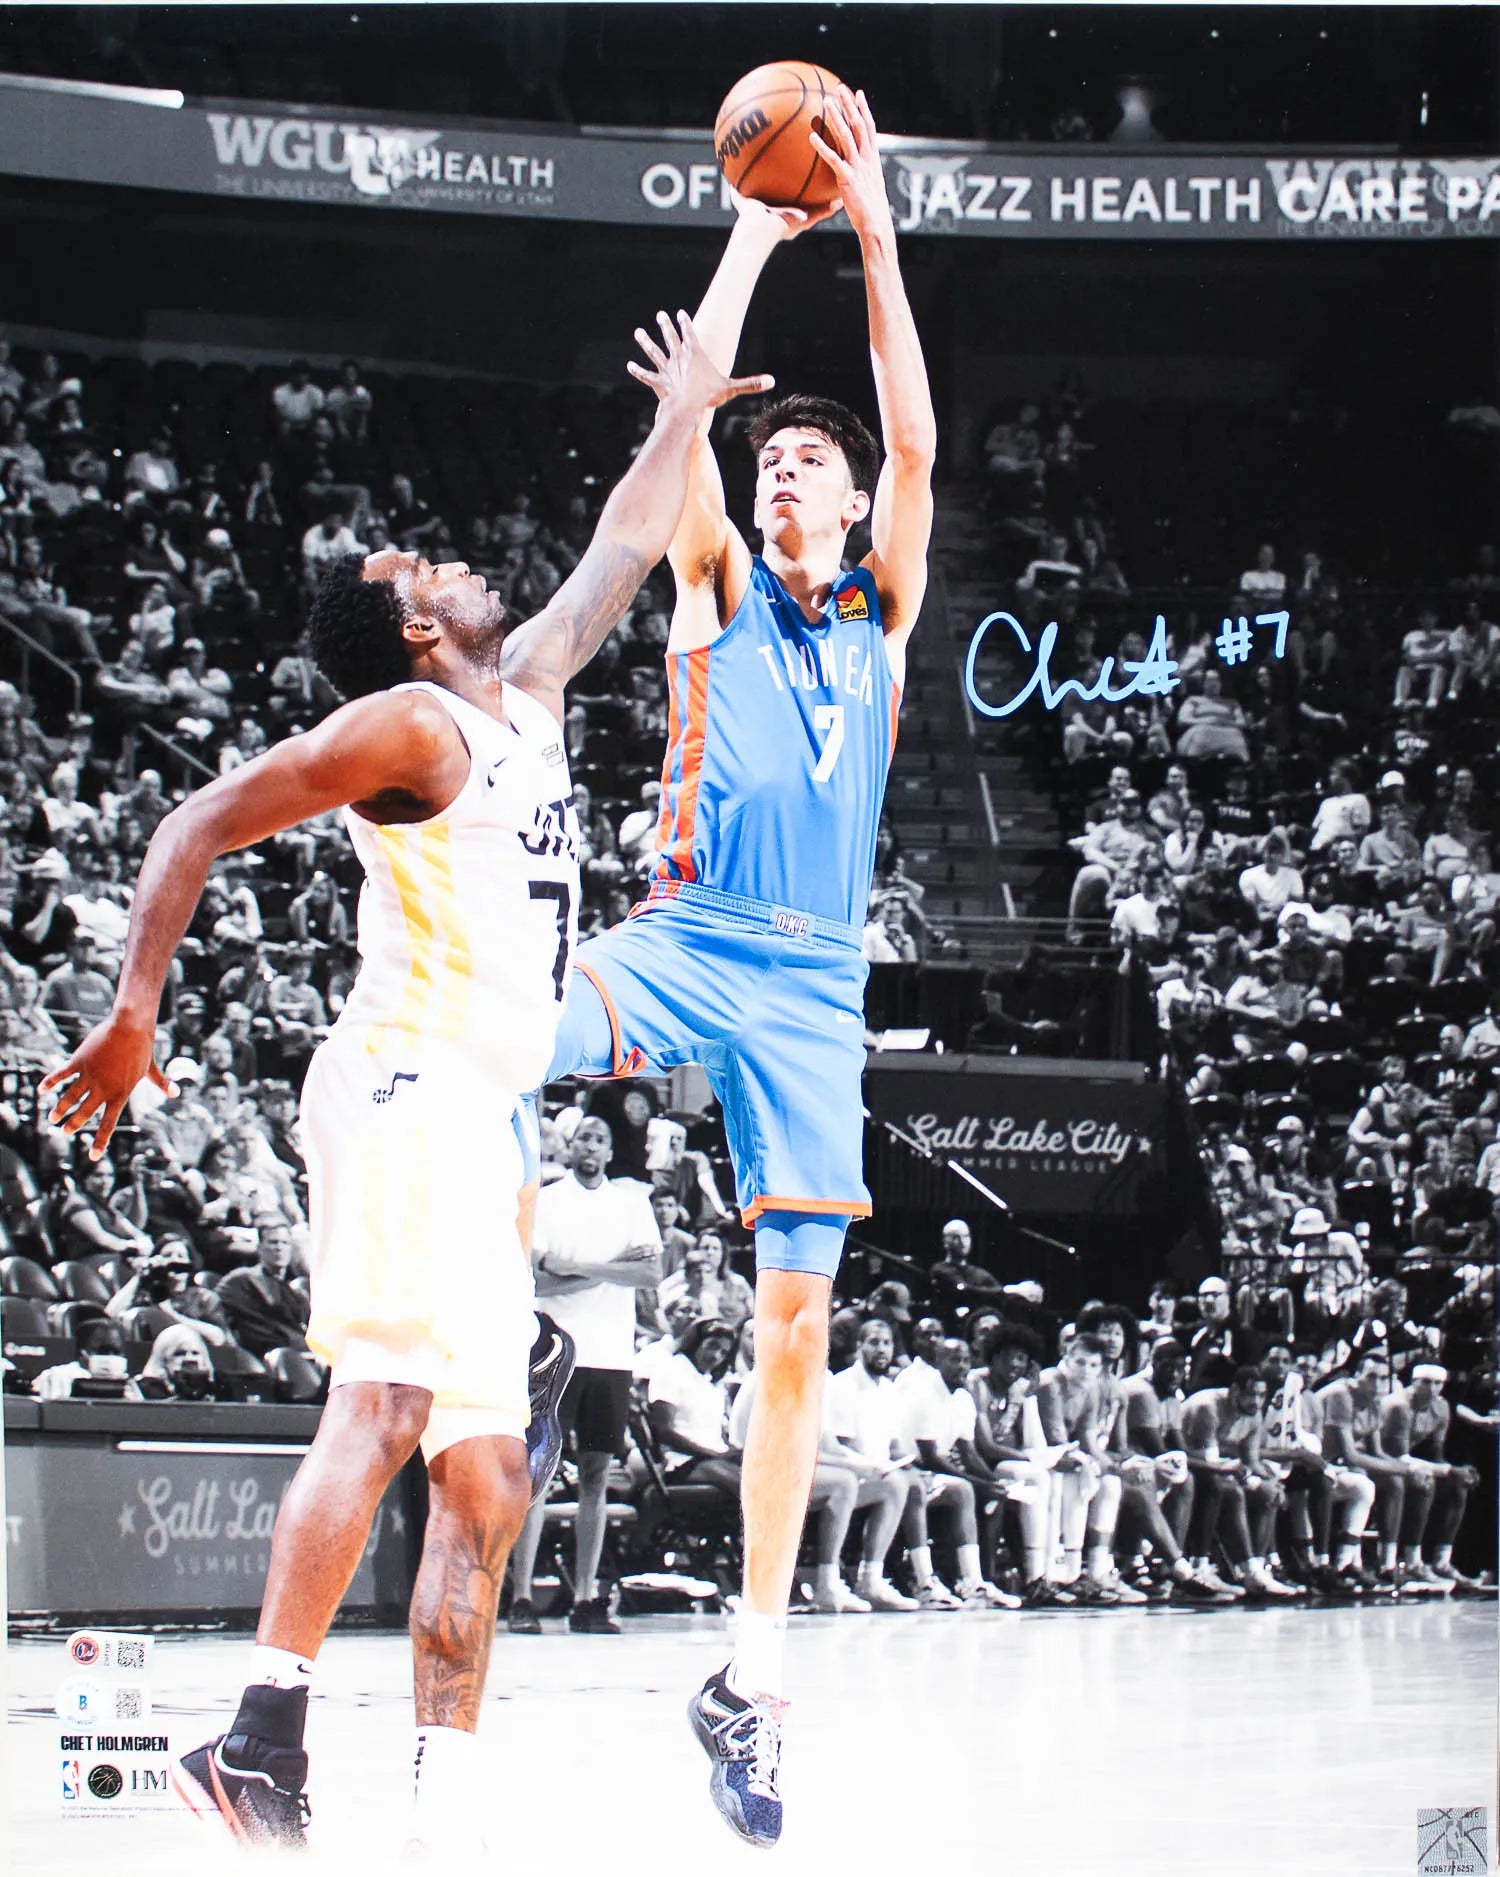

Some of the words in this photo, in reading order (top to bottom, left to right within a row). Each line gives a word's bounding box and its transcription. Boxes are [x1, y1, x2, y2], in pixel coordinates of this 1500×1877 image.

[416, 148, 555, 188] HEALTH
[898, 171, 1033, 230] JAZZ
[1050, 176, 1261, 223] HEALTH
[1277, 175, 1429, 224] CARE
[1215, 610, 1290, 666] #7
[811, 704, 845, 784] 7
[528, 880, 570, 1003] 7
[775, 912, 809, 937] OKC
[907, 1112, 980, 1157] Salt
[983, 1116, 1067, 1153] Lake
[1067, 1118, 1133, 1164] City
[138, 1476, 220, 1558] Salt
